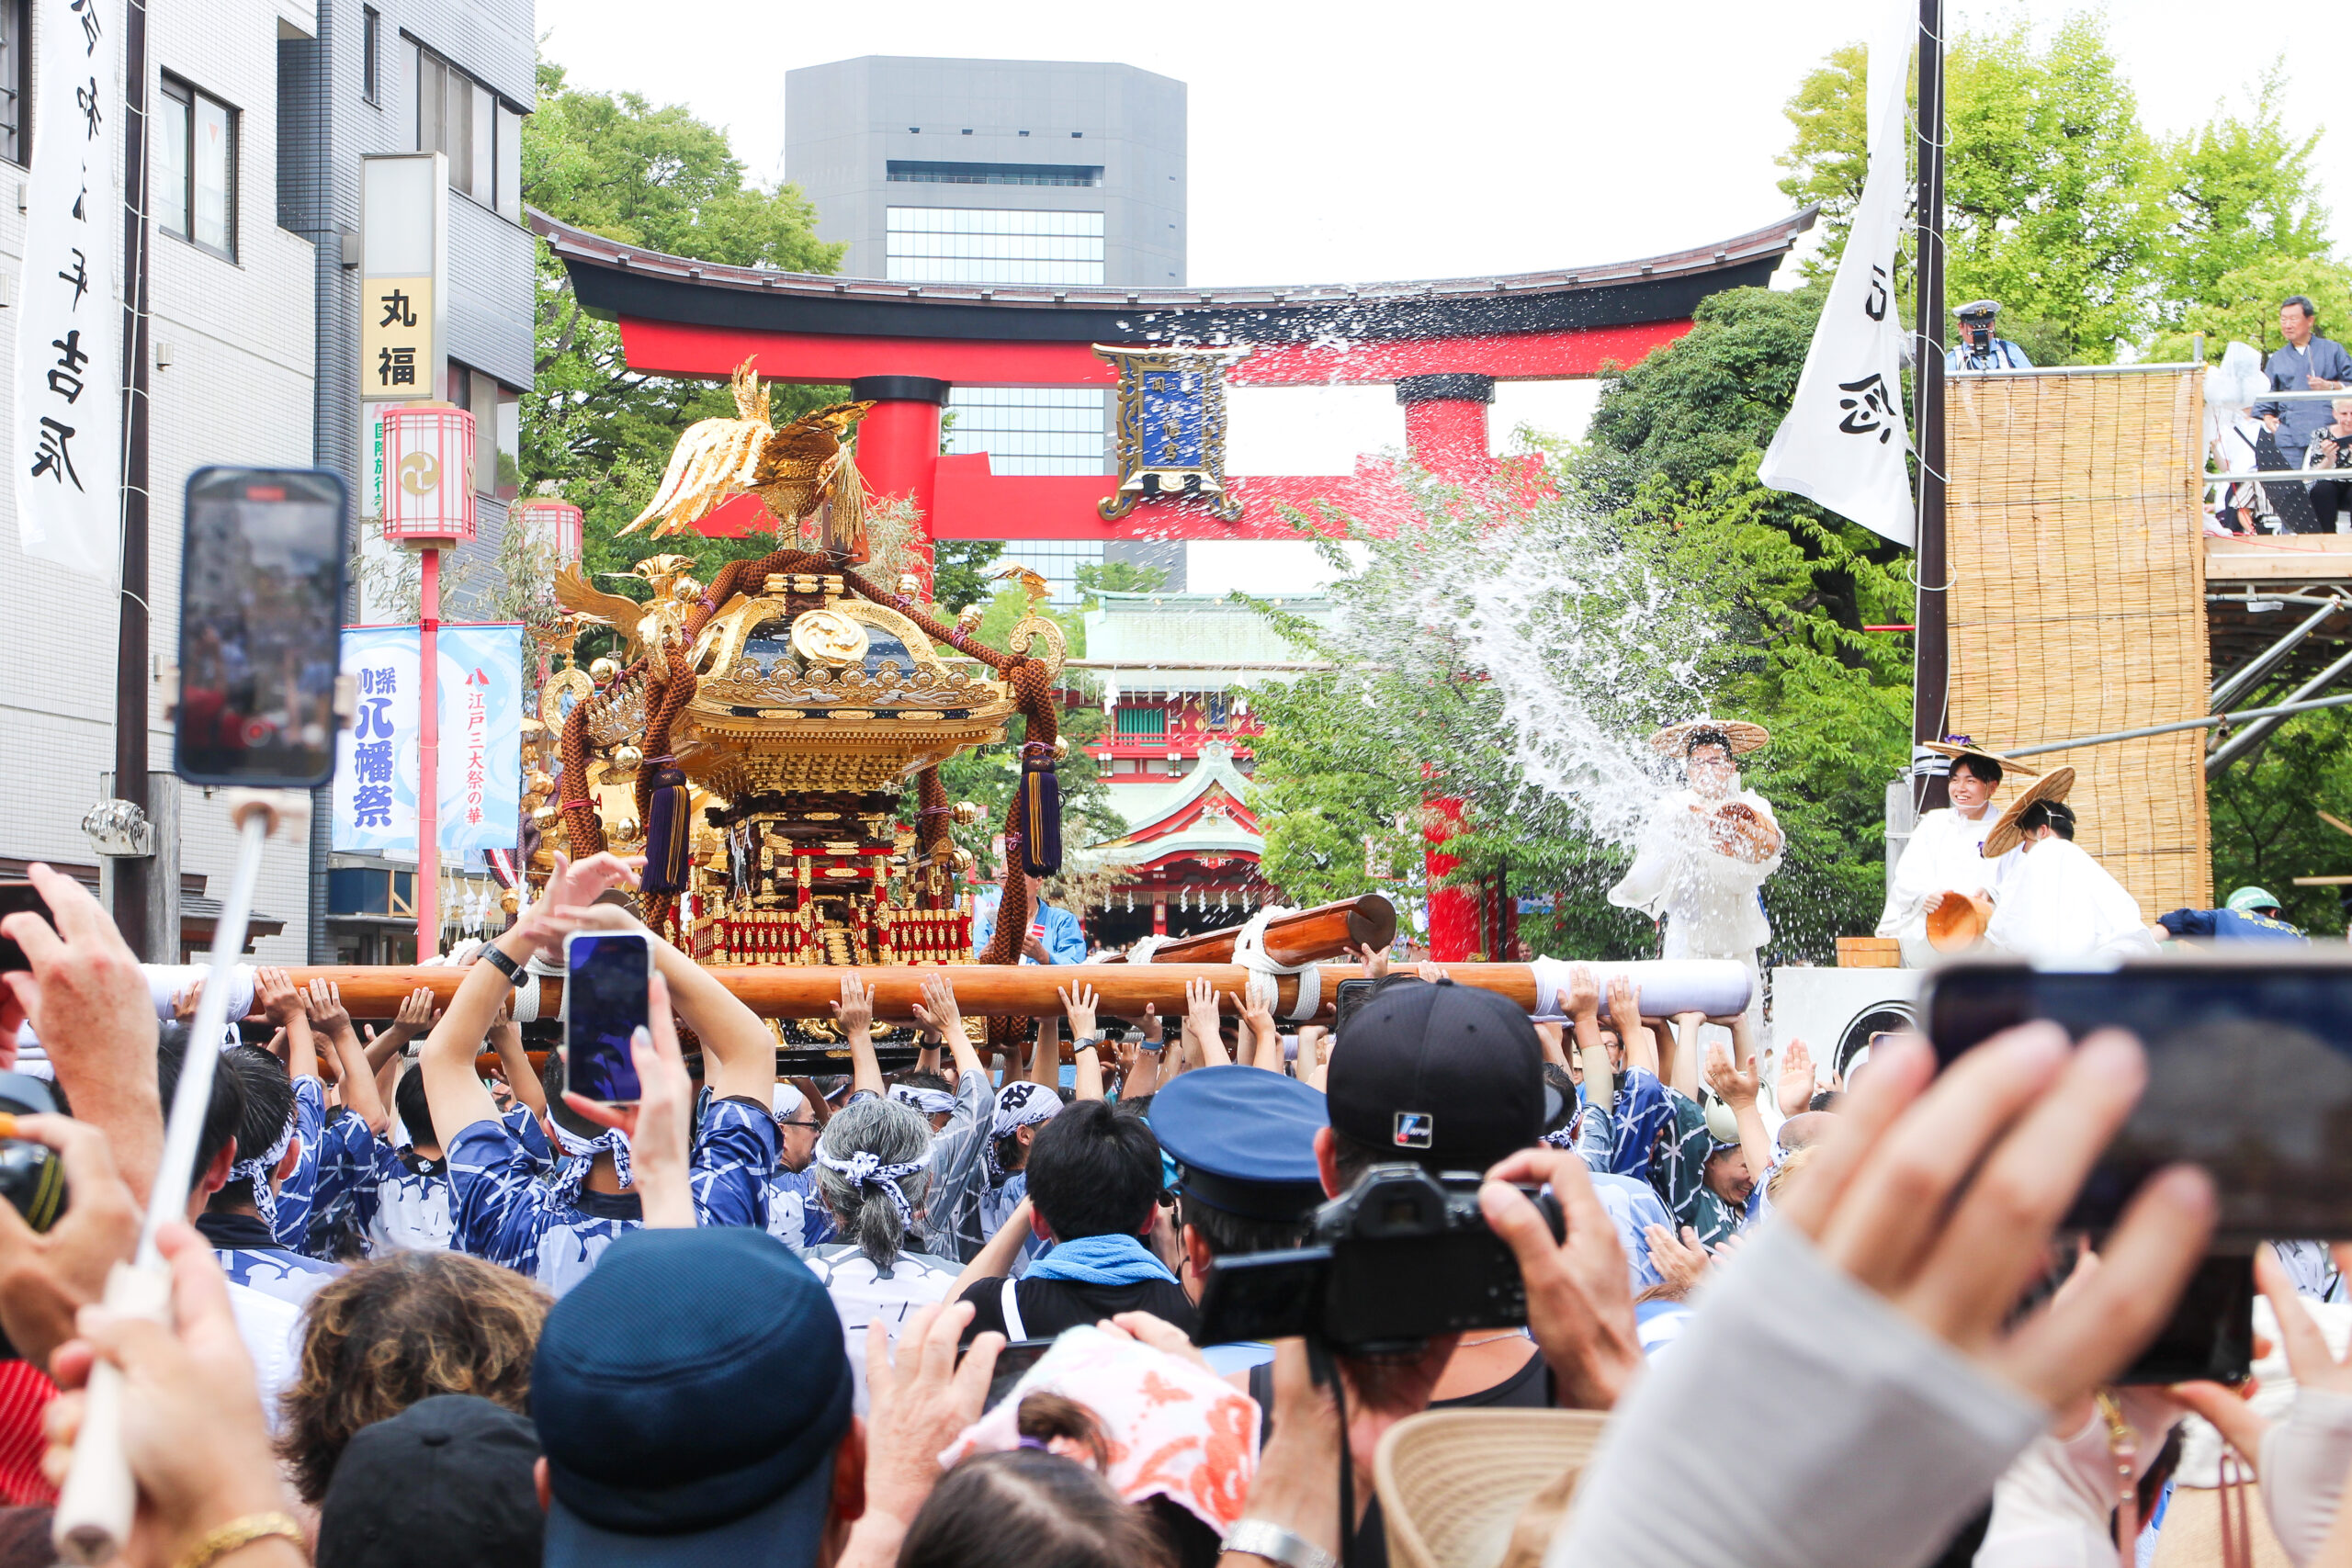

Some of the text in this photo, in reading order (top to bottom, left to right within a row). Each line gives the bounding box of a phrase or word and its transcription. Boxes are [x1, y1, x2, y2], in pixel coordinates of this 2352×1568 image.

[379, 289, 417, 386] 丸福
[354, 698, 395, 829] 八幡祭
[465, 692, 487, 826] 江戸三大祭の華
